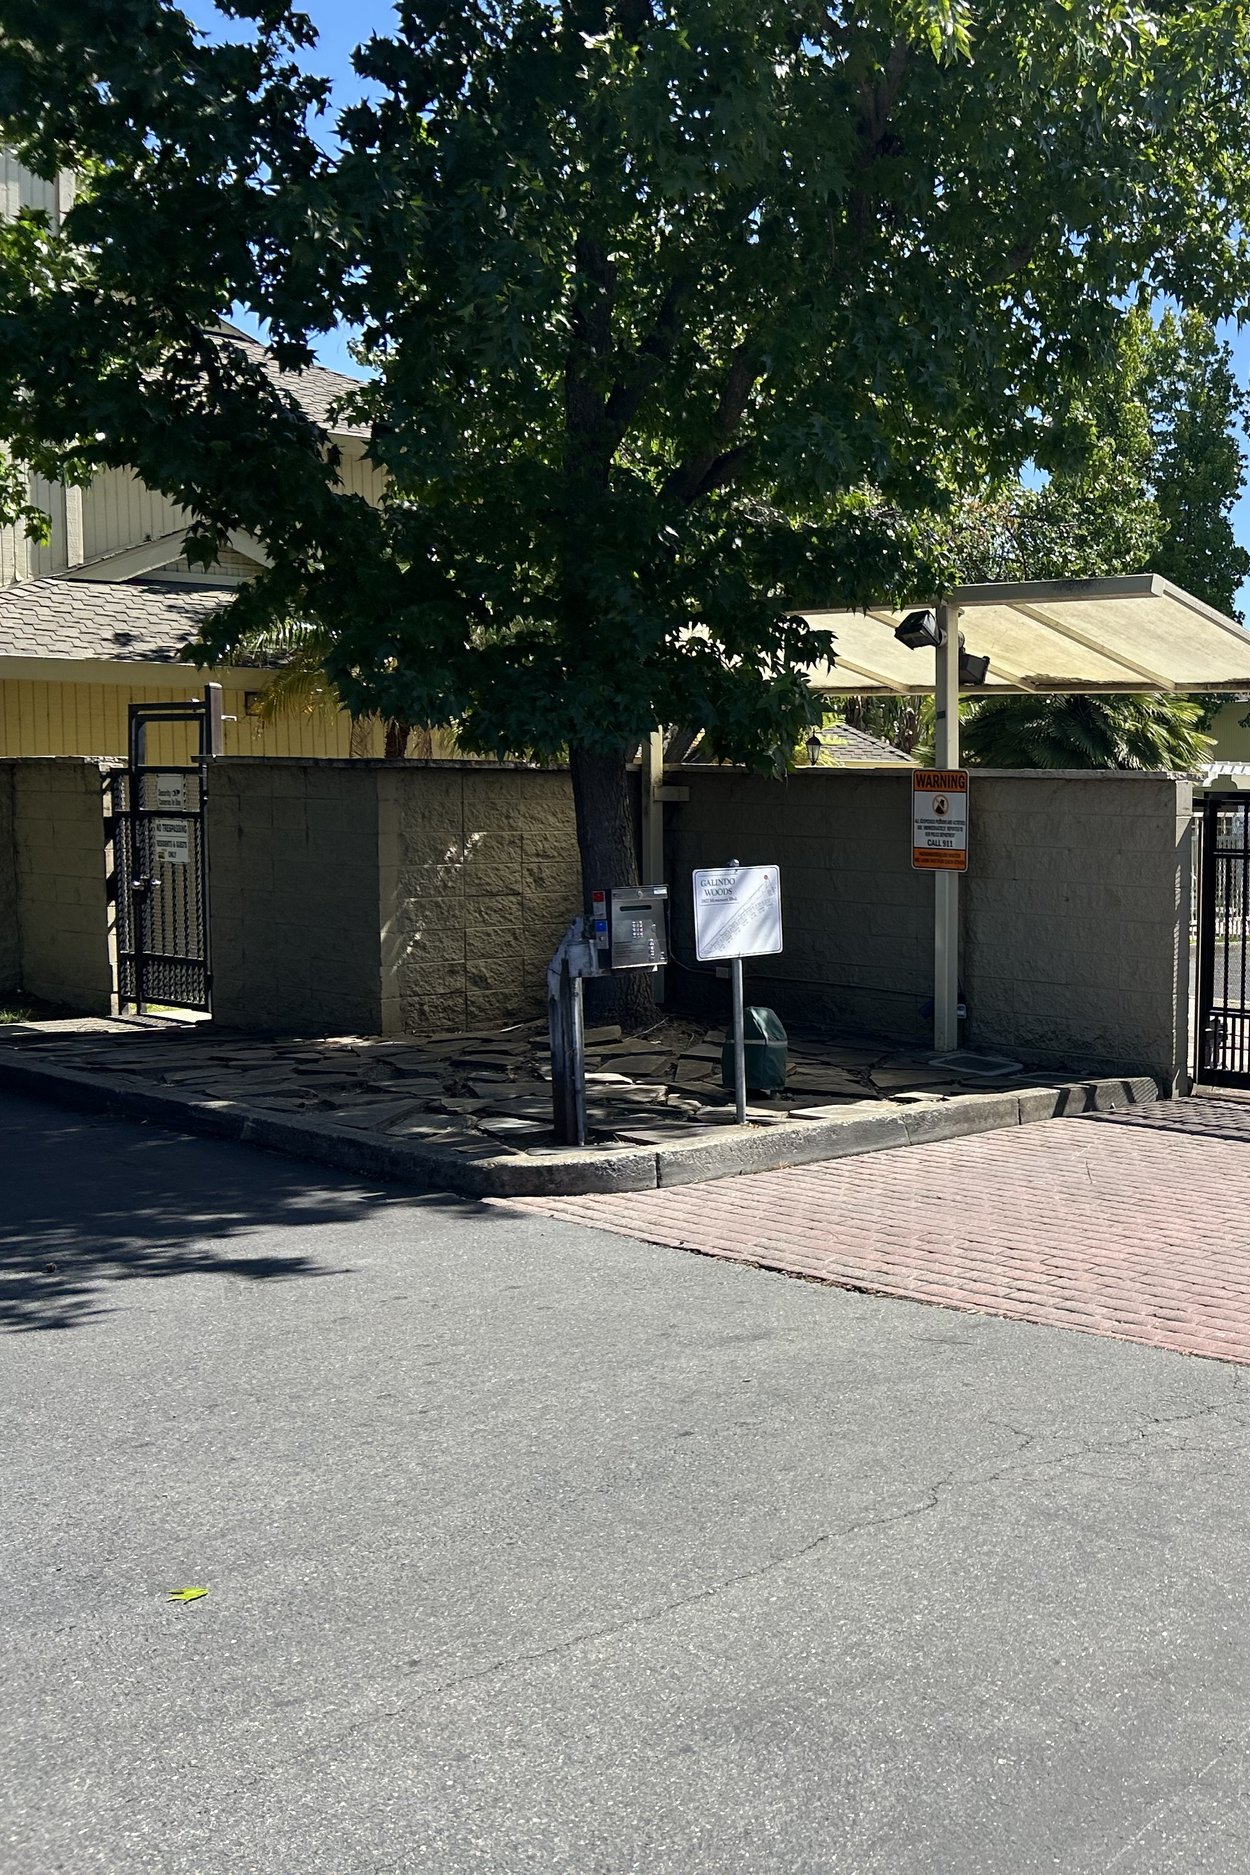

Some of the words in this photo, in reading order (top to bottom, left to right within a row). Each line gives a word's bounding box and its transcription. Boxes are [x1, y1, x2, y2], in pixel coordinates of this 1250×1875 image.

[916, 774, 965, 789] WARNING
[927, 839, 941, 847] CALL
[700, 878, 736, 887] GALINDO
[704, 888, 733, 896] WOODS
